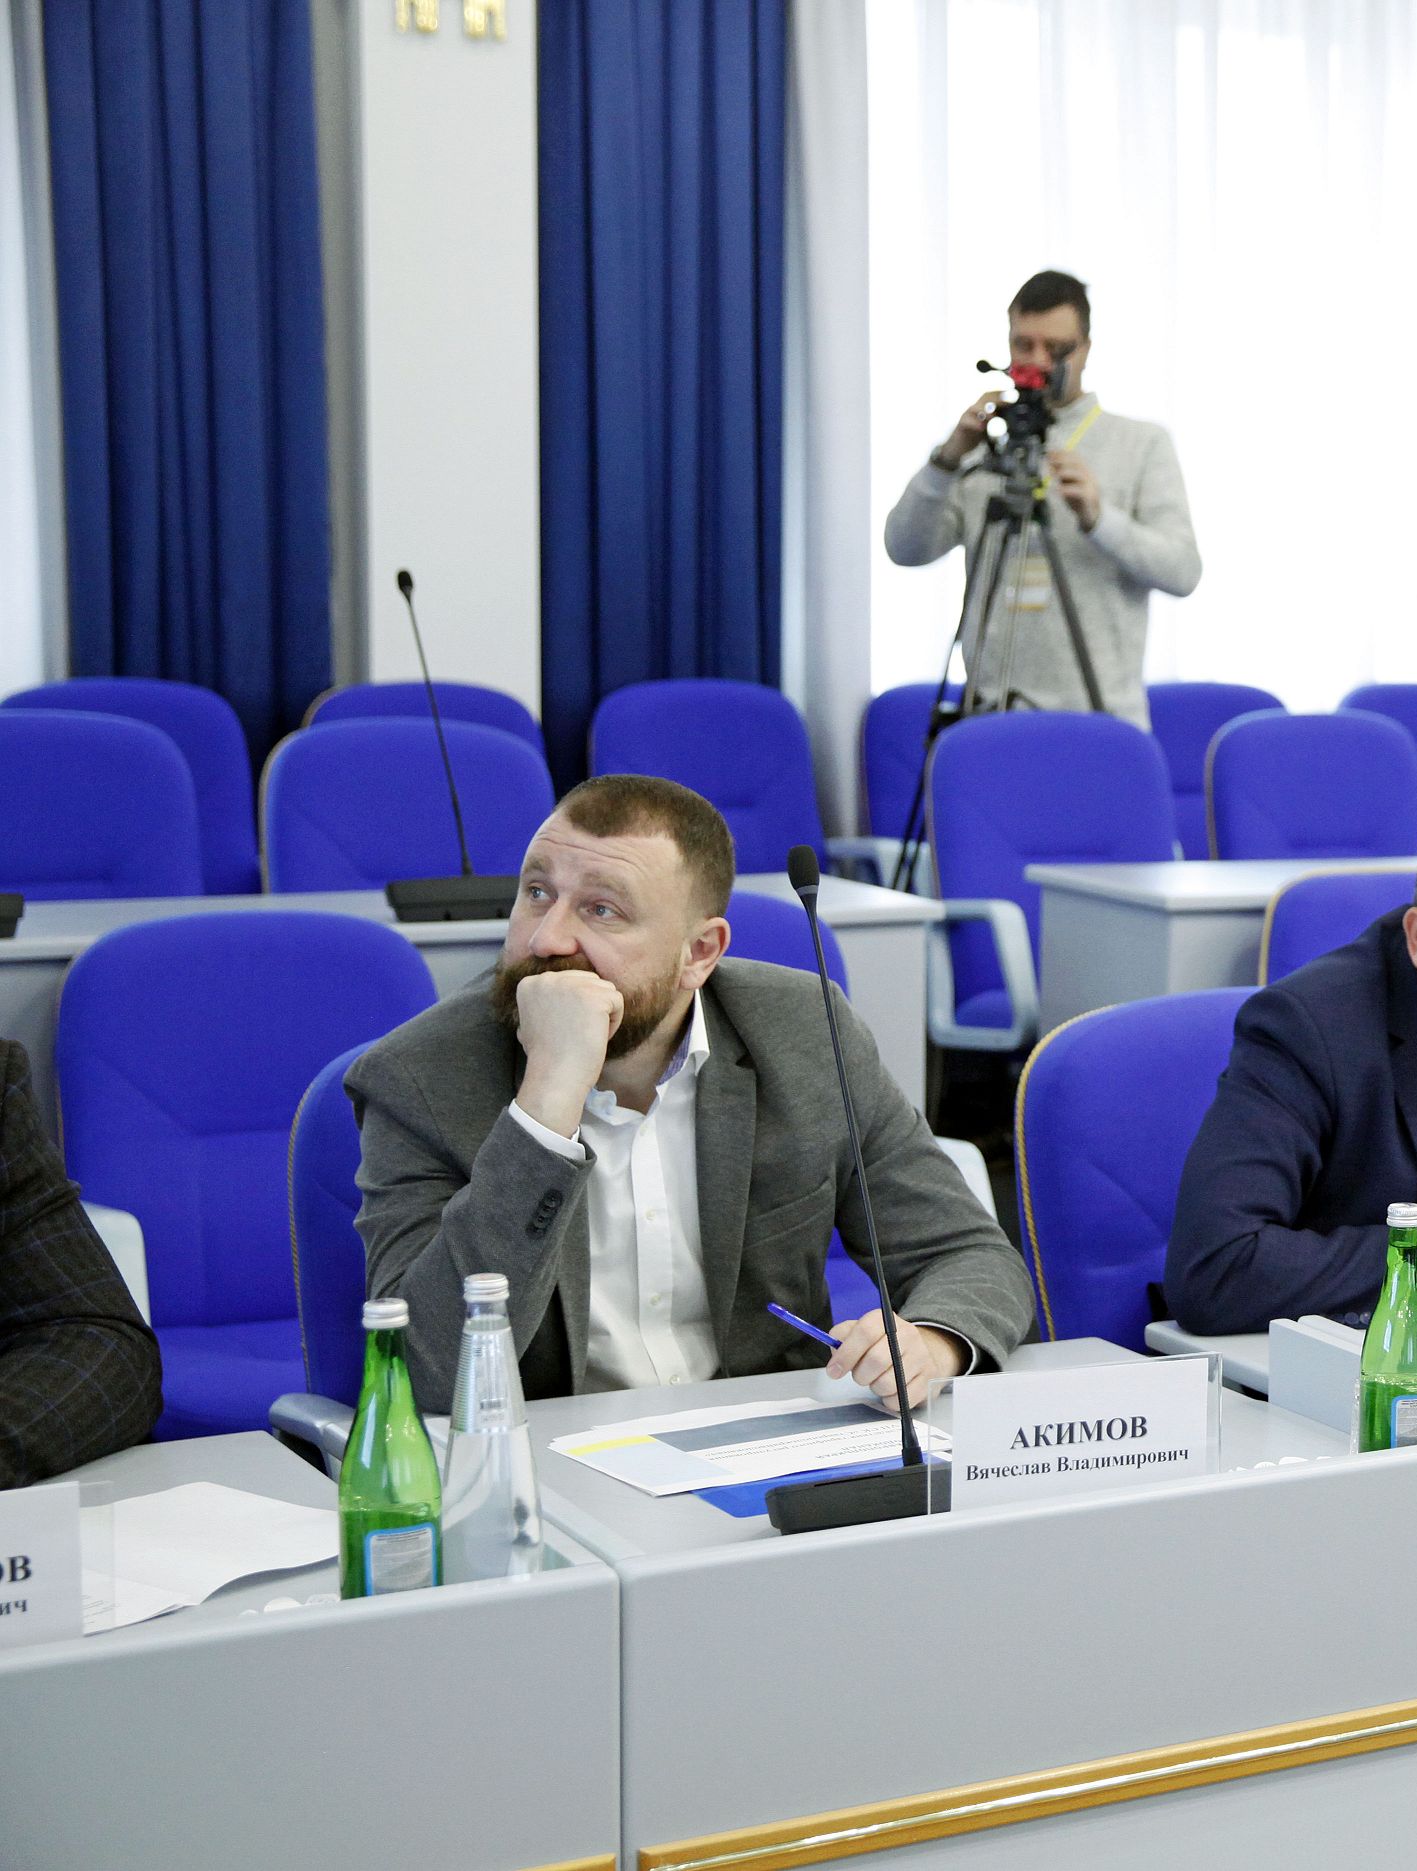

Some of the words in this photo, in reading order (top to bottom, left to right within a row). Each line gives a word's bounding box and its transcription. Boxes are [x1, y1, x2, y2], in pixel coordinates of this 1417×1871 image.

[1010, 1415, 1149, 1450] АКИМОВ
[966, 1460, 1051, 1482] Вячеслав
[1056, 1446, 1190, 1473] Владимирович
[0, 1555, 32, 1583] В
